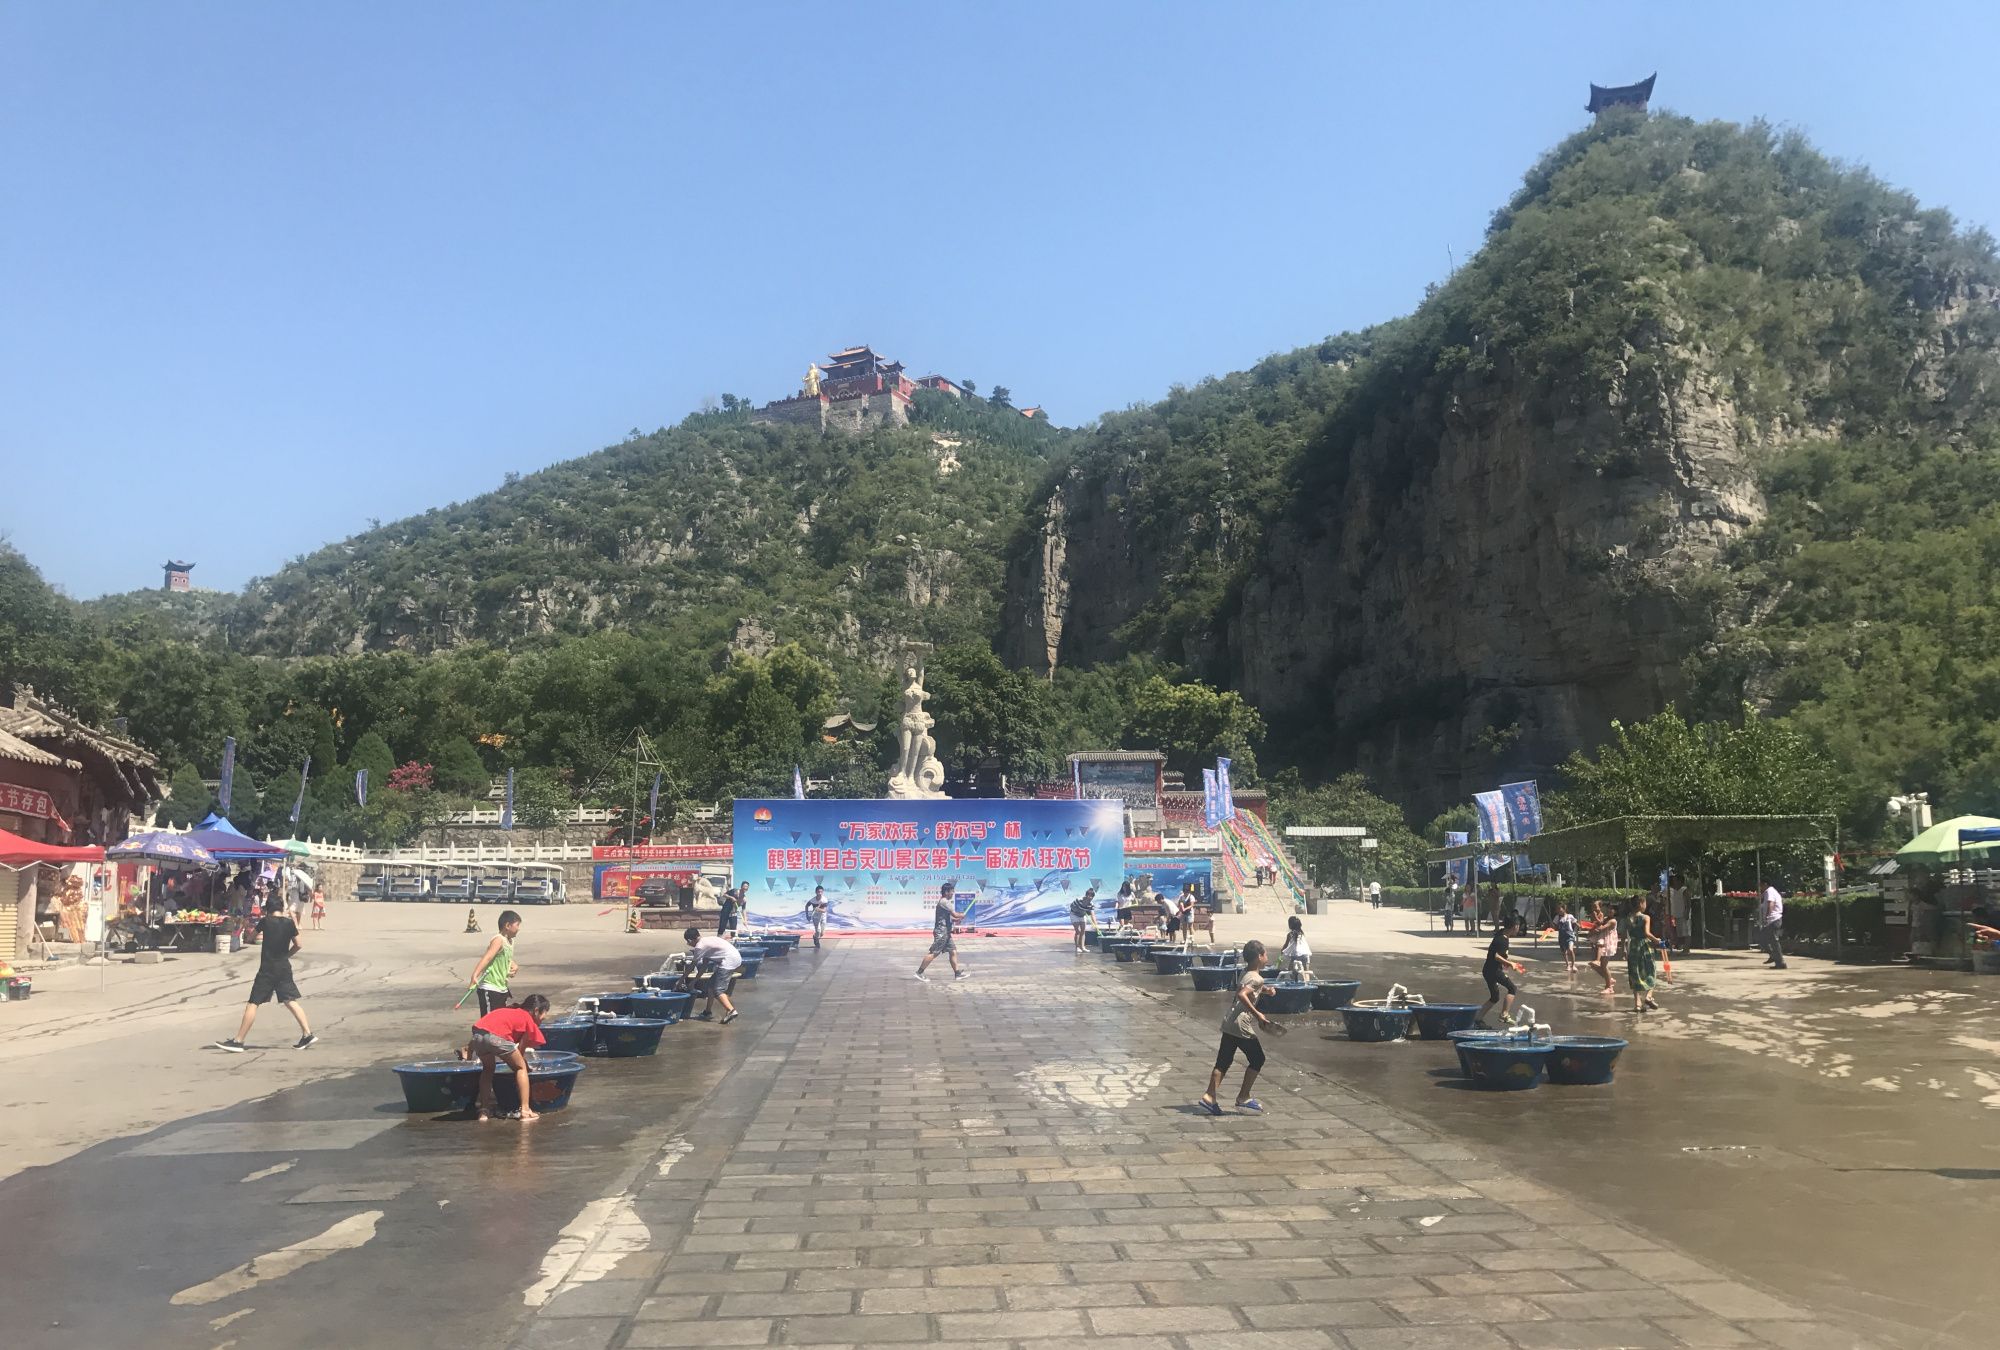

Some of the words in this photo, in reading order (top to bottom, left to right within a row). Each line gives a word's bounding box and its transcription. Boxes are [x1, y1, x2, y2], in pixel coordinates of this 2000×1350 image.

[767, 847, 1091, 870] 鹤壁淇县古灵山景区第十一届泼水狂欢节
